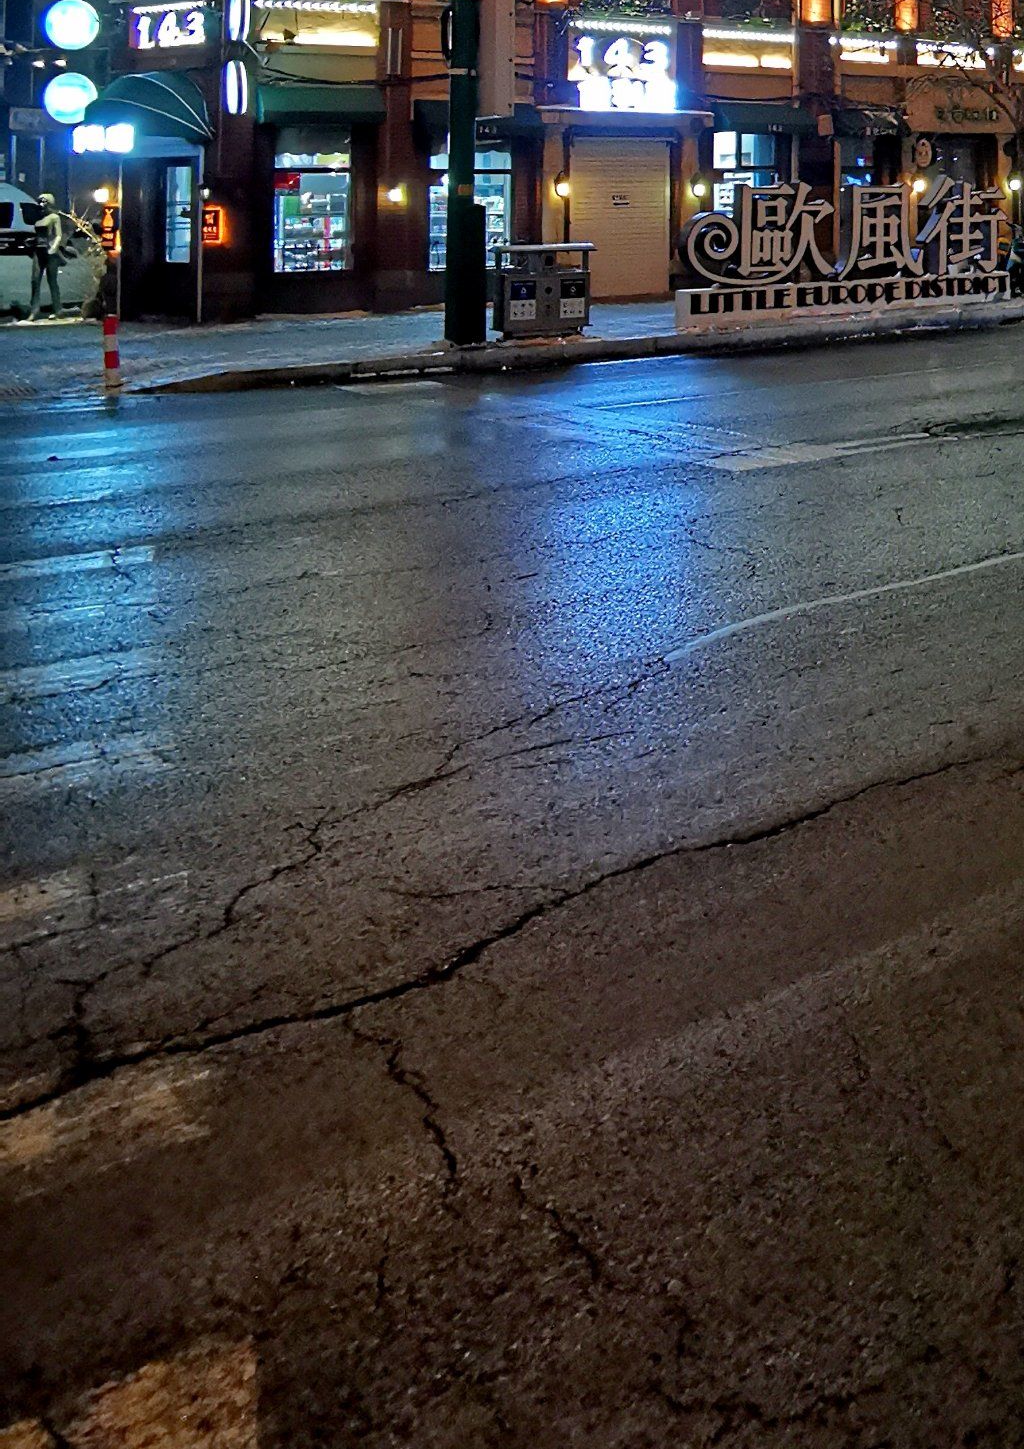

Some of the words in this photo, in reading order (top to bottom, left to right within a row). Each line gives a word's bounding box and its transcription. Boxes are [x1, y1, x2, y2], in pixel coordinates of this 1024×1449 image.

[136, 12, 206, 49] 143
[576, 36, 669, 71] 143
[687, 177, 1008, 285] 歐風街
[690, 288, 792, 315] LITTLE
[796, 282, 902, 307] EUROPE
[904, 274, 1010, 300] DISTRICT
